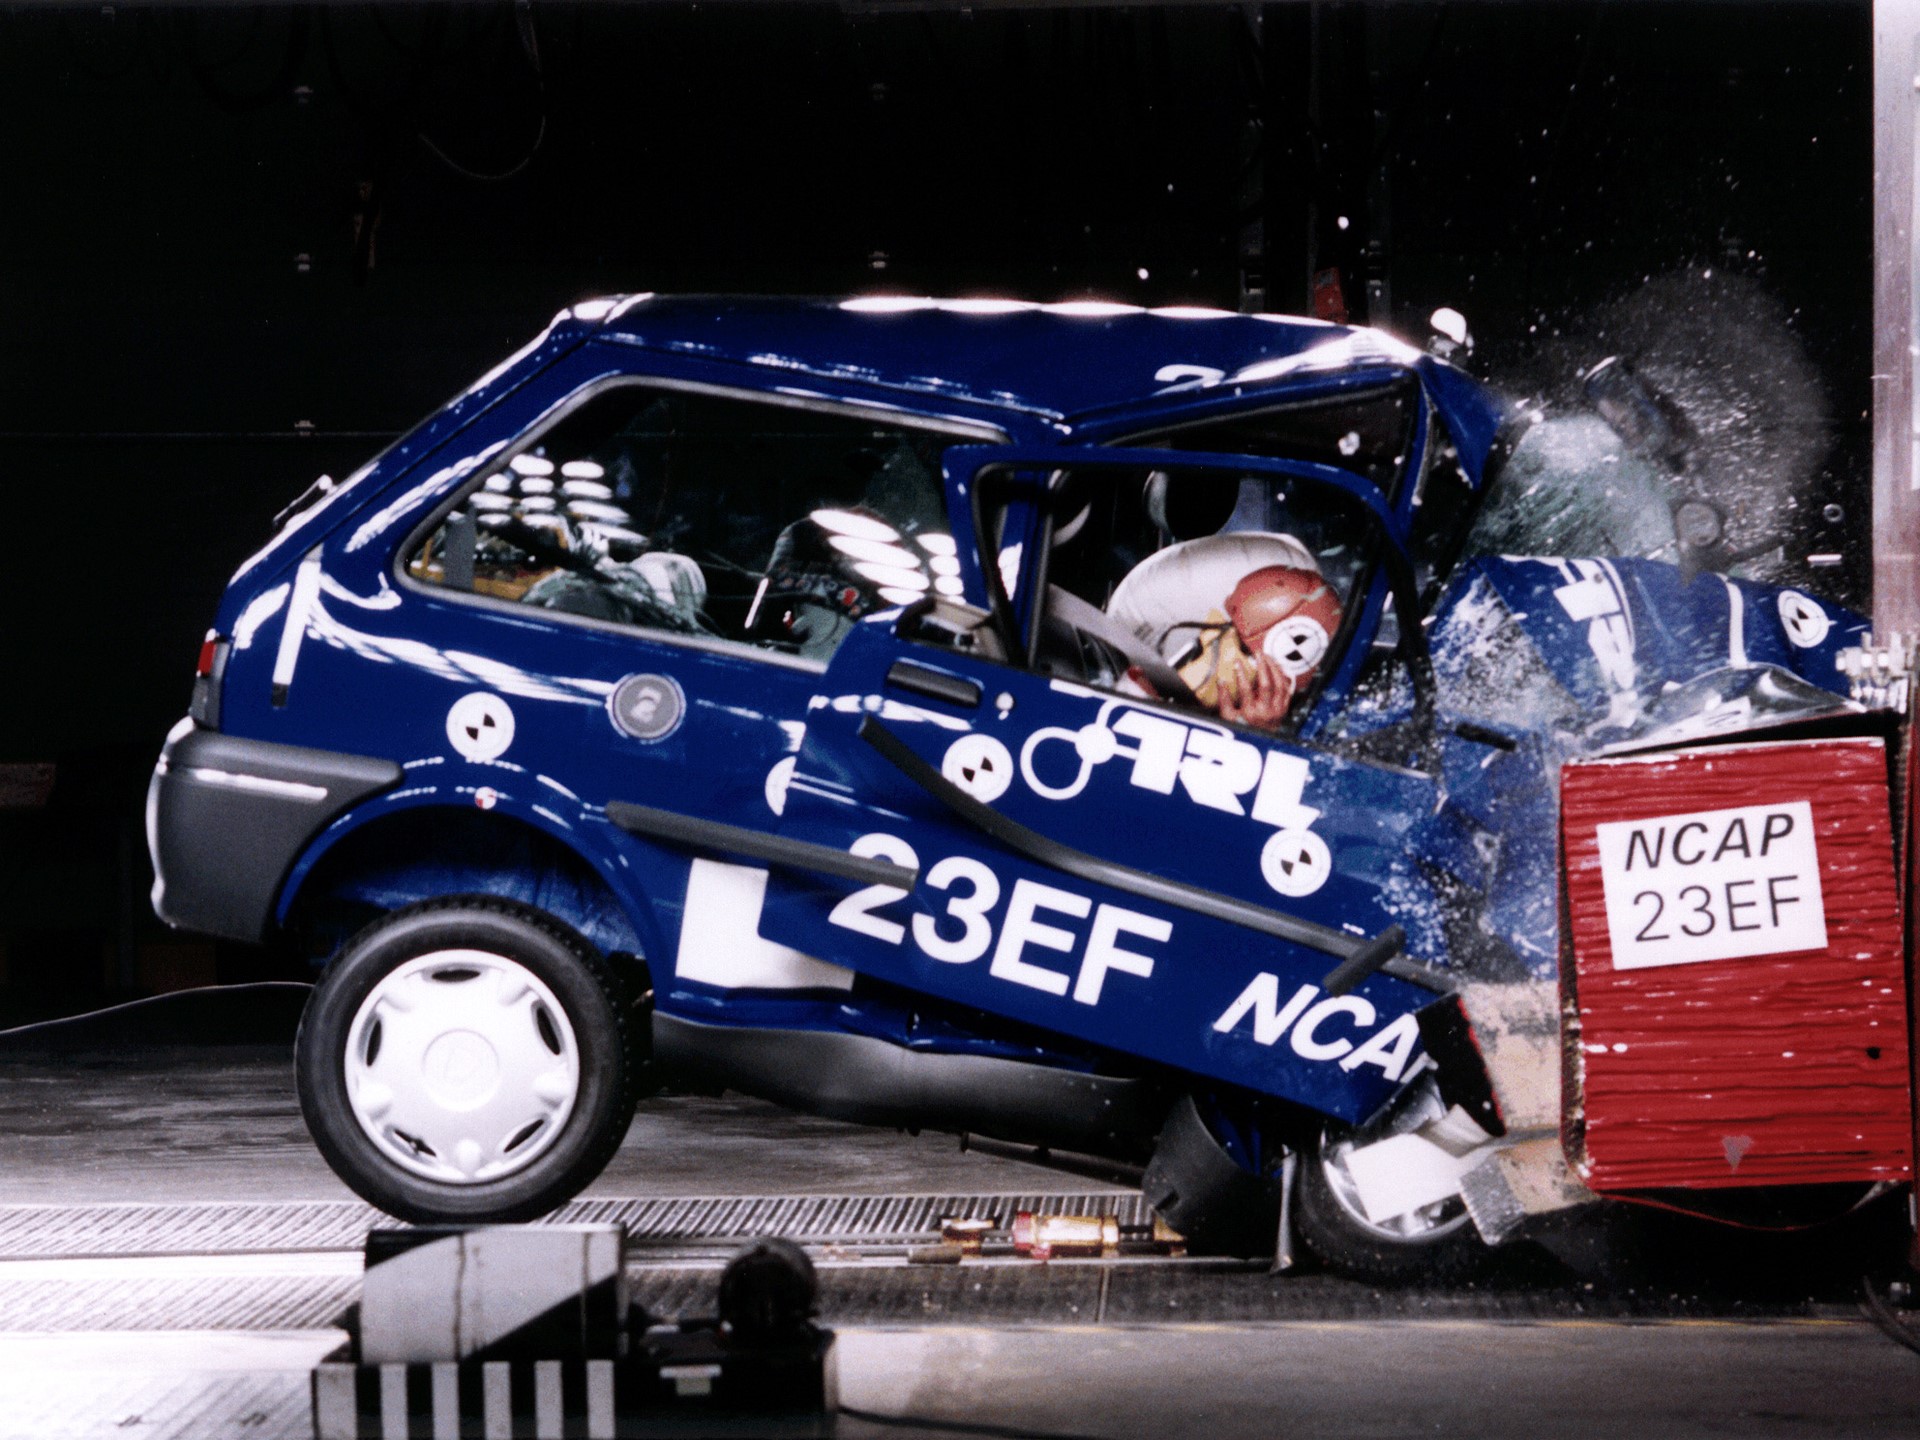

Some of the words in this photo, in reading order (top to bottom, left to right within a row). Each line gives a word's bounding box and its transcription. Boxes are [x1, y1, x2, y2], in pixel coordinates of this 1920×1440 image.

[1625, 813, 1794, 871] NCAP
[828, 833, 1173, 1005] 23EF
[1633, 875, 1800, 942] 23EF
